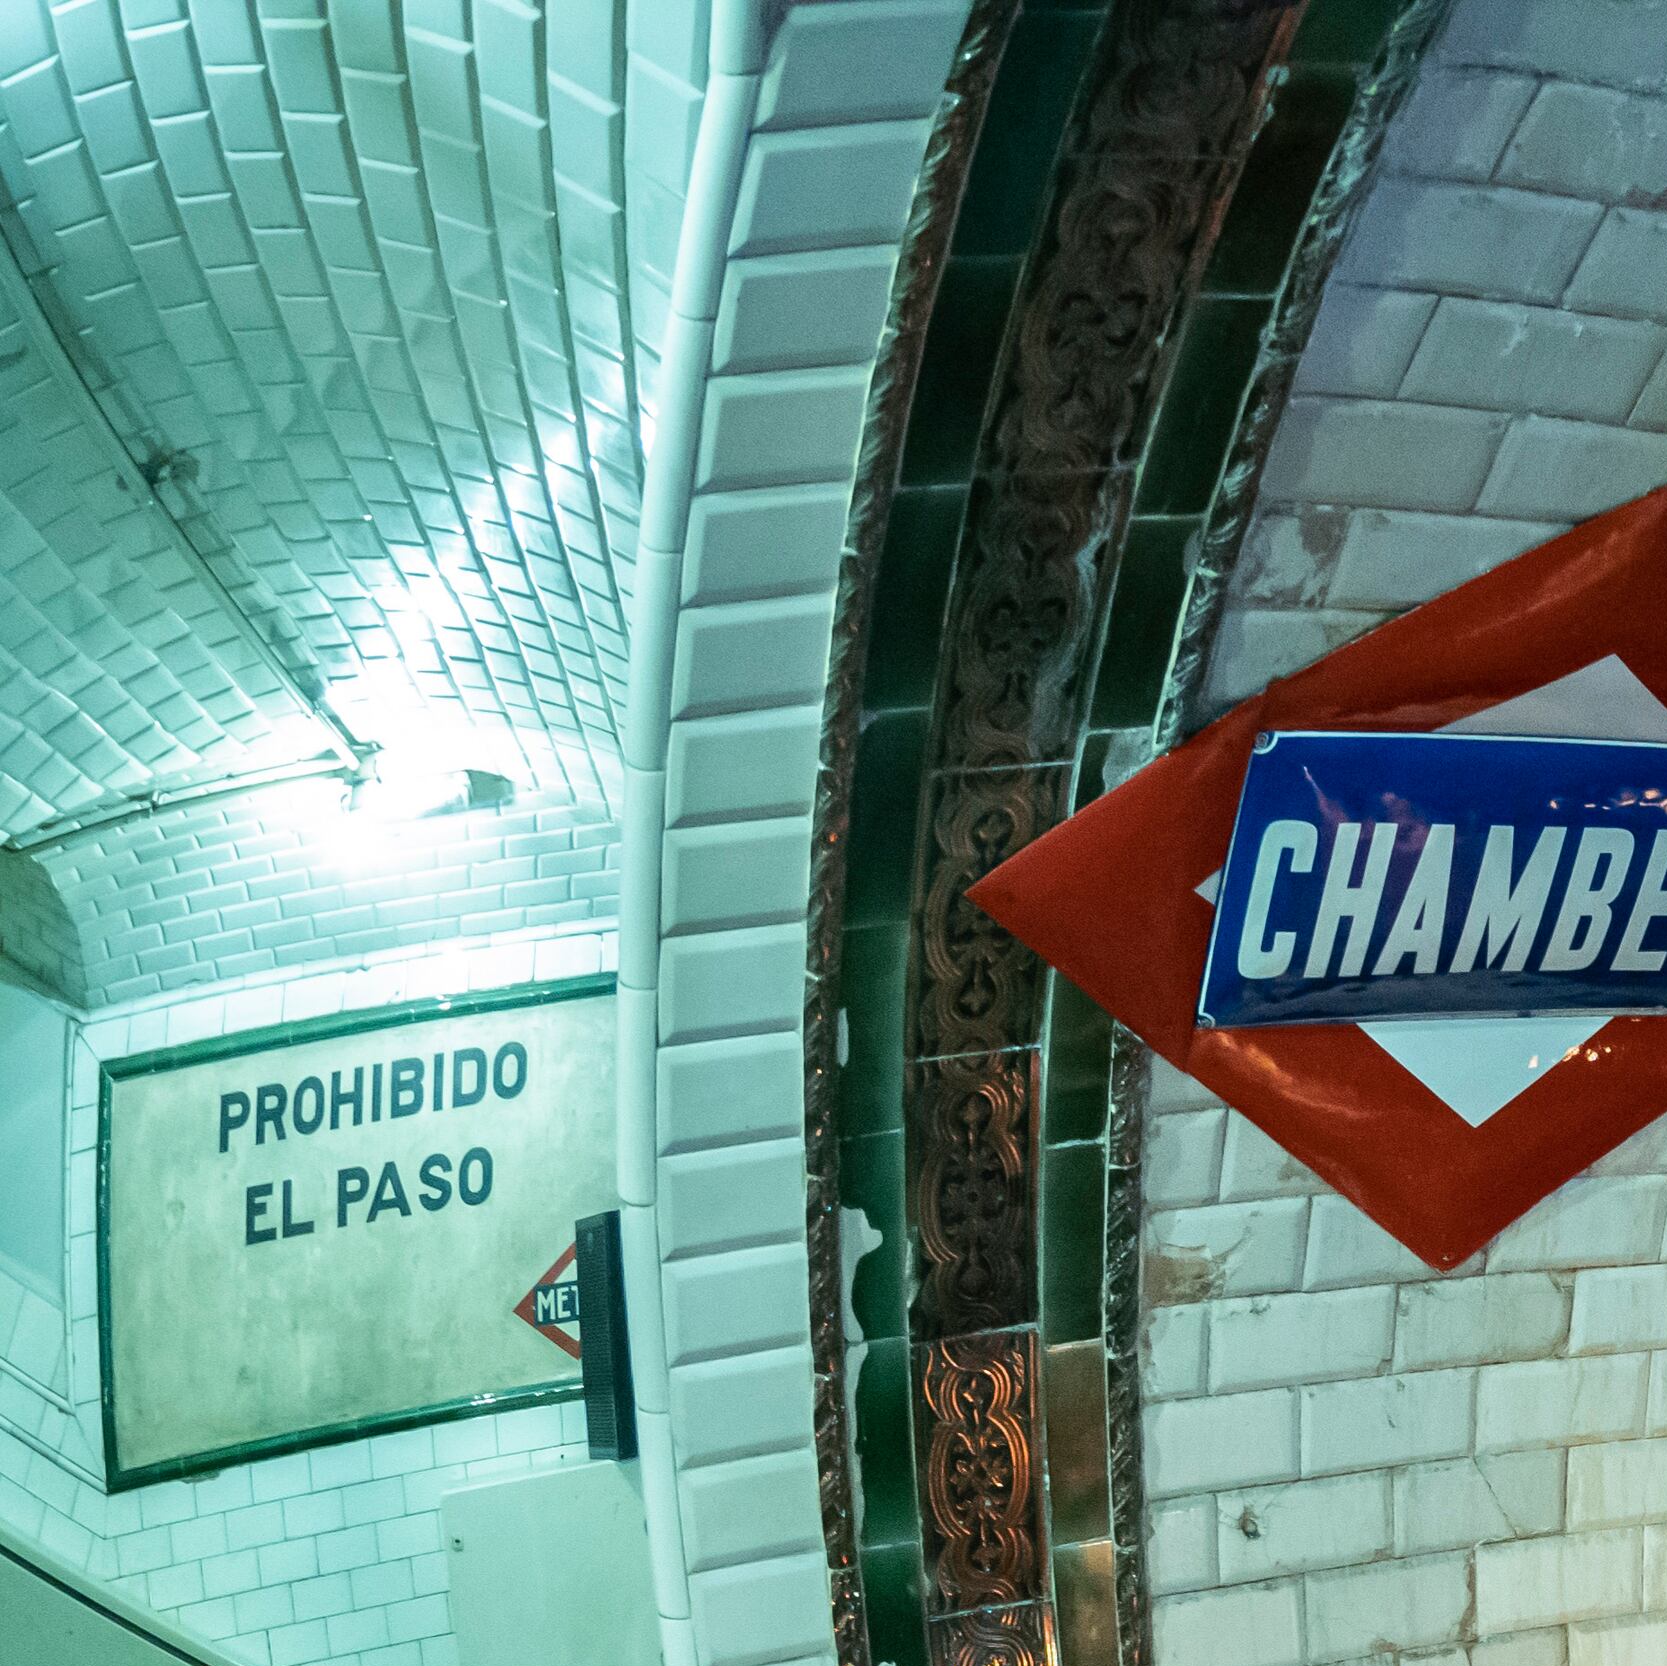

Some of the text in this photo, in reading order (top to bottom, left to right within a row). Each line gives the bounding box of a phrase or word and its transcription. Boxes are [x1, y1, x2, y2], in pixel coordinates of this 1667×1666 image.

[218, 1041, 529, 1154] PROHIBIDO
[245, 1146, 494, 1246] EL PASO
